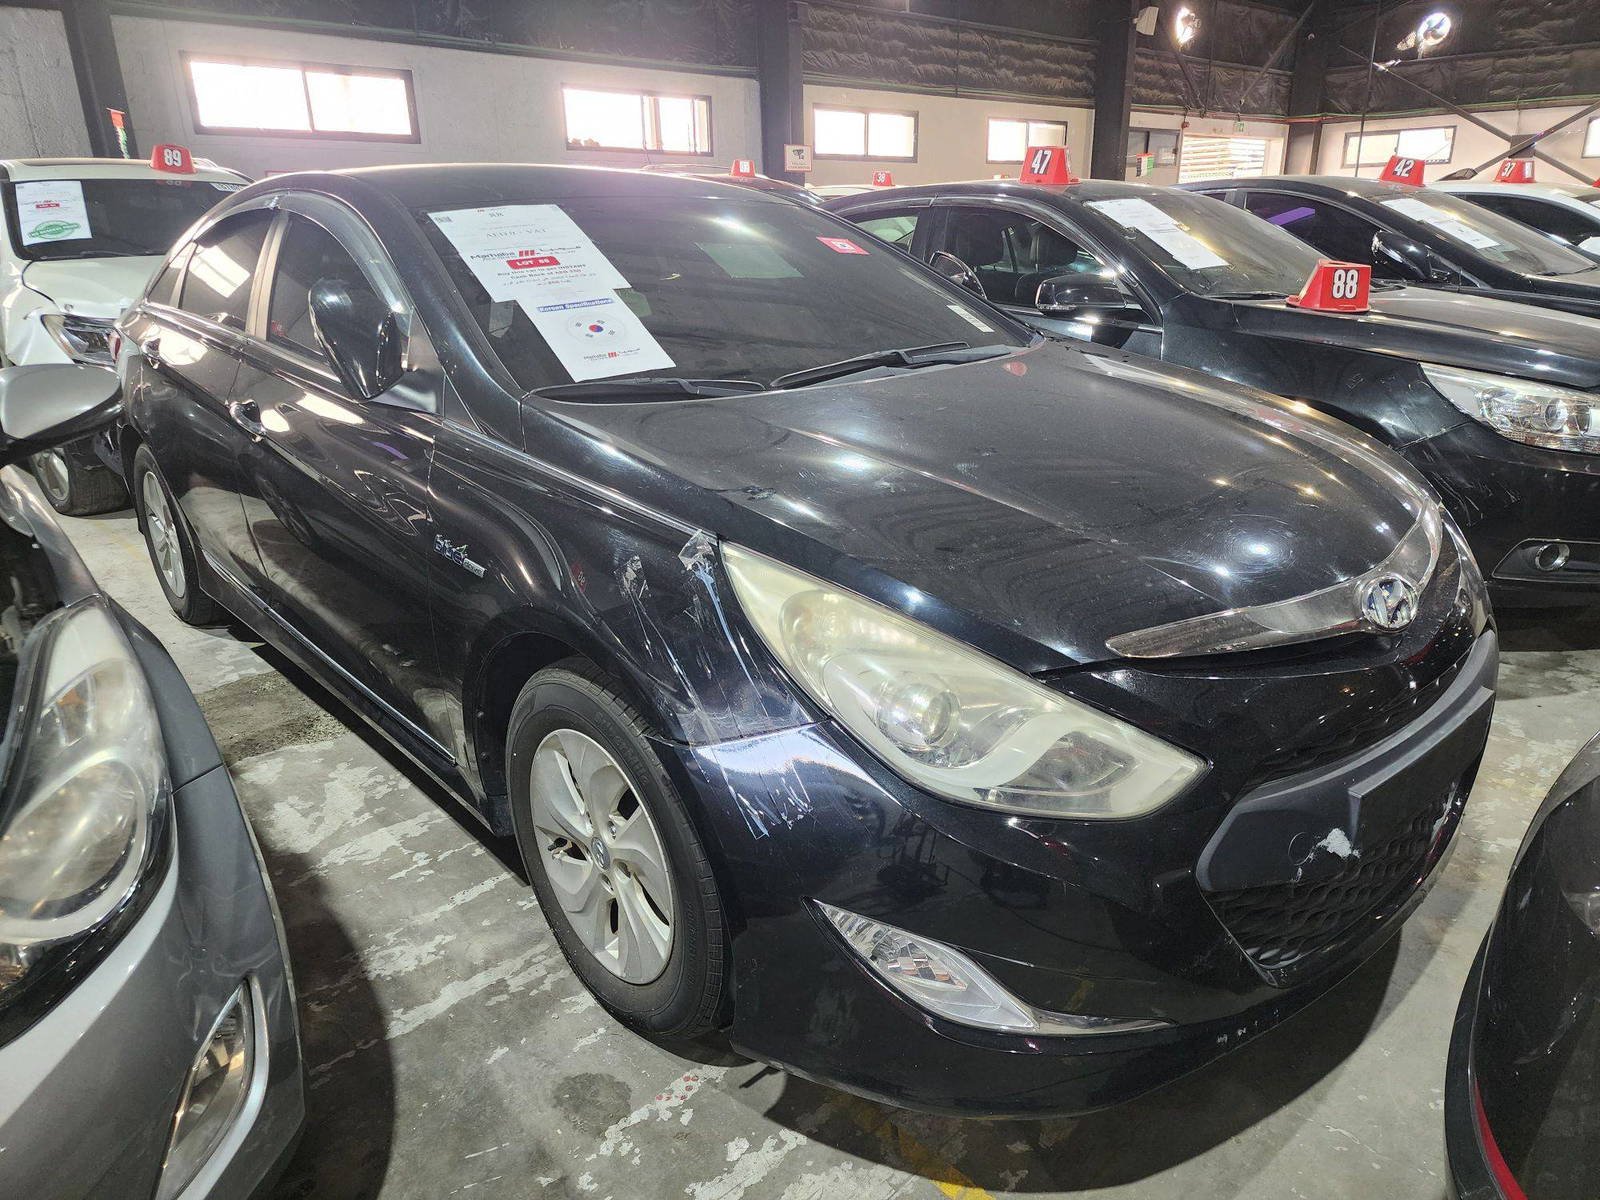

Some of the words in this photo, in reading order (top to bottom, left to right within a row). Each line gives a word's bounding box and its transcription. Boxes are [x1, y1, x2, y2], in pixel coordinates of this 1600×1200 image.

[164, 148, 182, 167] 89
[1032, 149, 1052, 175] 47
[1394, 158, 1415, 177] 42
[1501, 162, 1515, 177] 37
[1332, 269, 1359, 299] 88
[565, 298, 613, 309] Specifications
